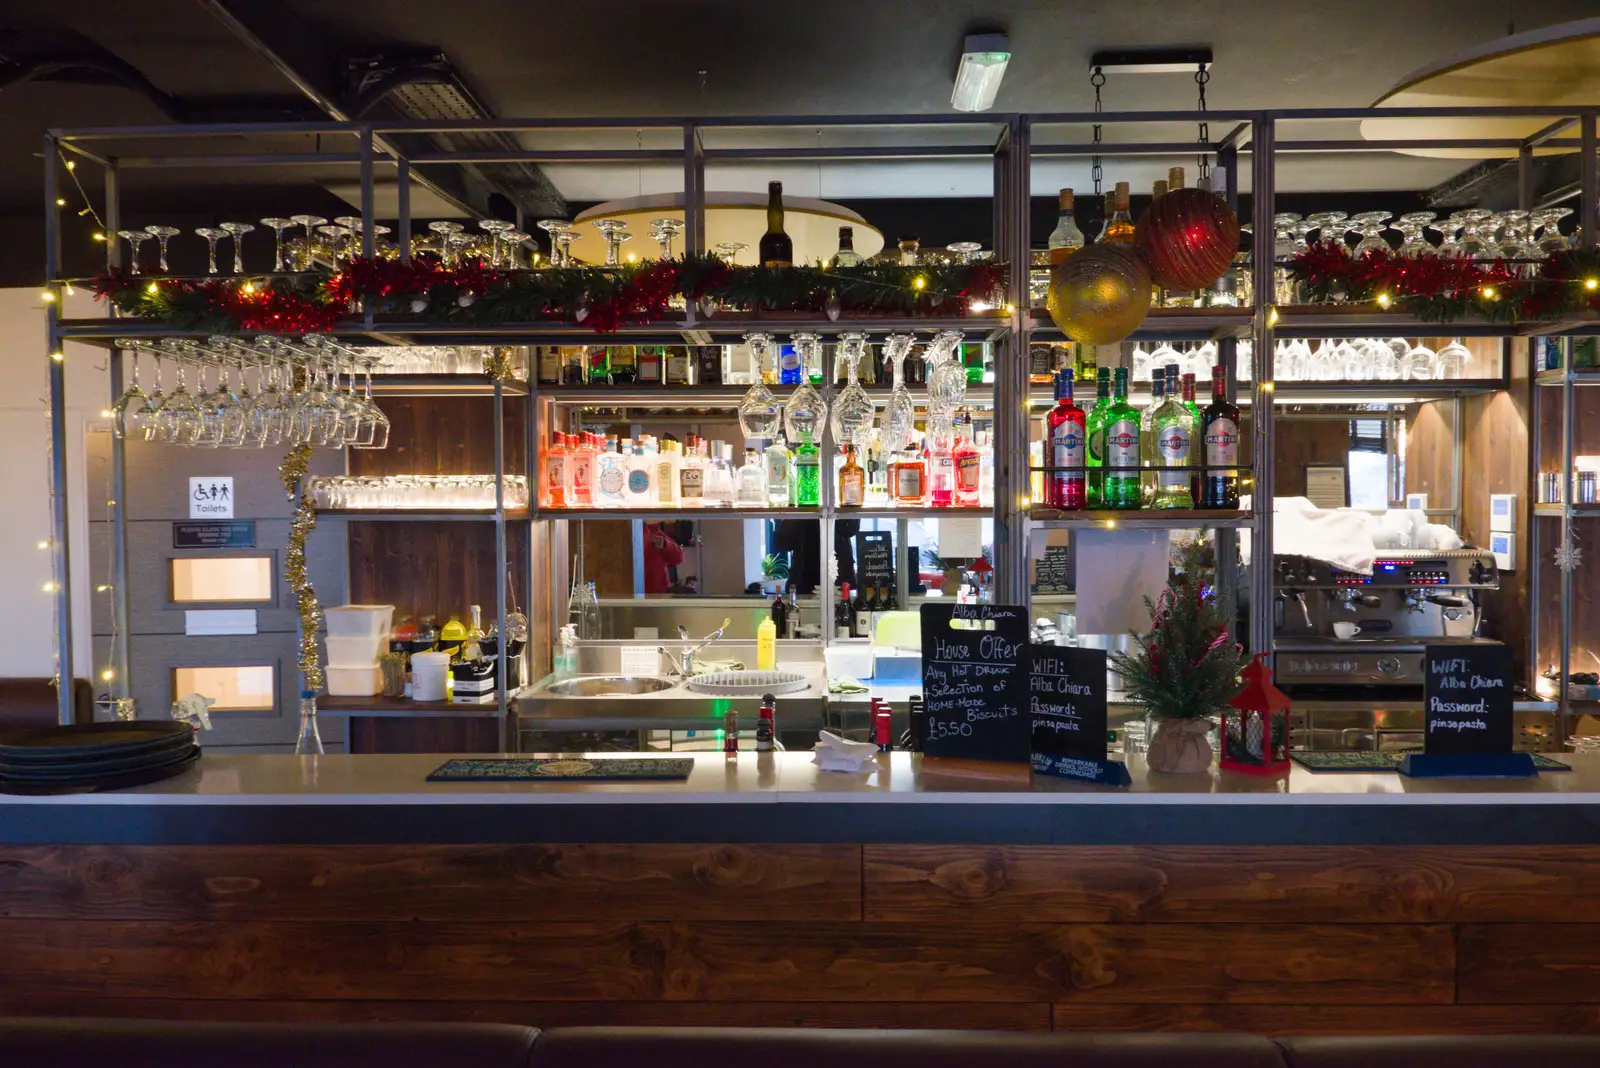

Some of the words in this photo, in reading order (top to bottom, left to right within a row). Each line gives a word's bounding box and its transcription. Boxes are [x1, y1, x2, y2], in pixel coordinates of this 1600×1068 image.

[1055, 437, 1084, 446] MARTINI
[1109, 436, 1138, 445] MARTINI
[1161, 439, 1189, 447] MARTINI
[1207, 436, 1237, 444] MARTINI
[196, 504, 227, 513] Toilets
[951, 604, 976, 619] Alba
[981, 606, 1017, 619] Chiara
[934, 636, 970, 660] House
[980, 634, 1024, 660] Offer
[925, 665, 946, 685] Any
[1440, 676, 1466, 688] Alba
[1470, 674, 1504, 689] Chiara
[993, 679, 1007, 692] of
[1030, 676, 1054, 692] Alba
[1058, 676, 1092, 696] Chiara
[1031, 695, 1075, 715] Password:
[1430, 696, 1489, 714] Password:
[967, 704, 1018, 722] Biscuits
[927, 716, 972, 740] £5.50
[1061, 757, 1099, 768] REMARKABLE
